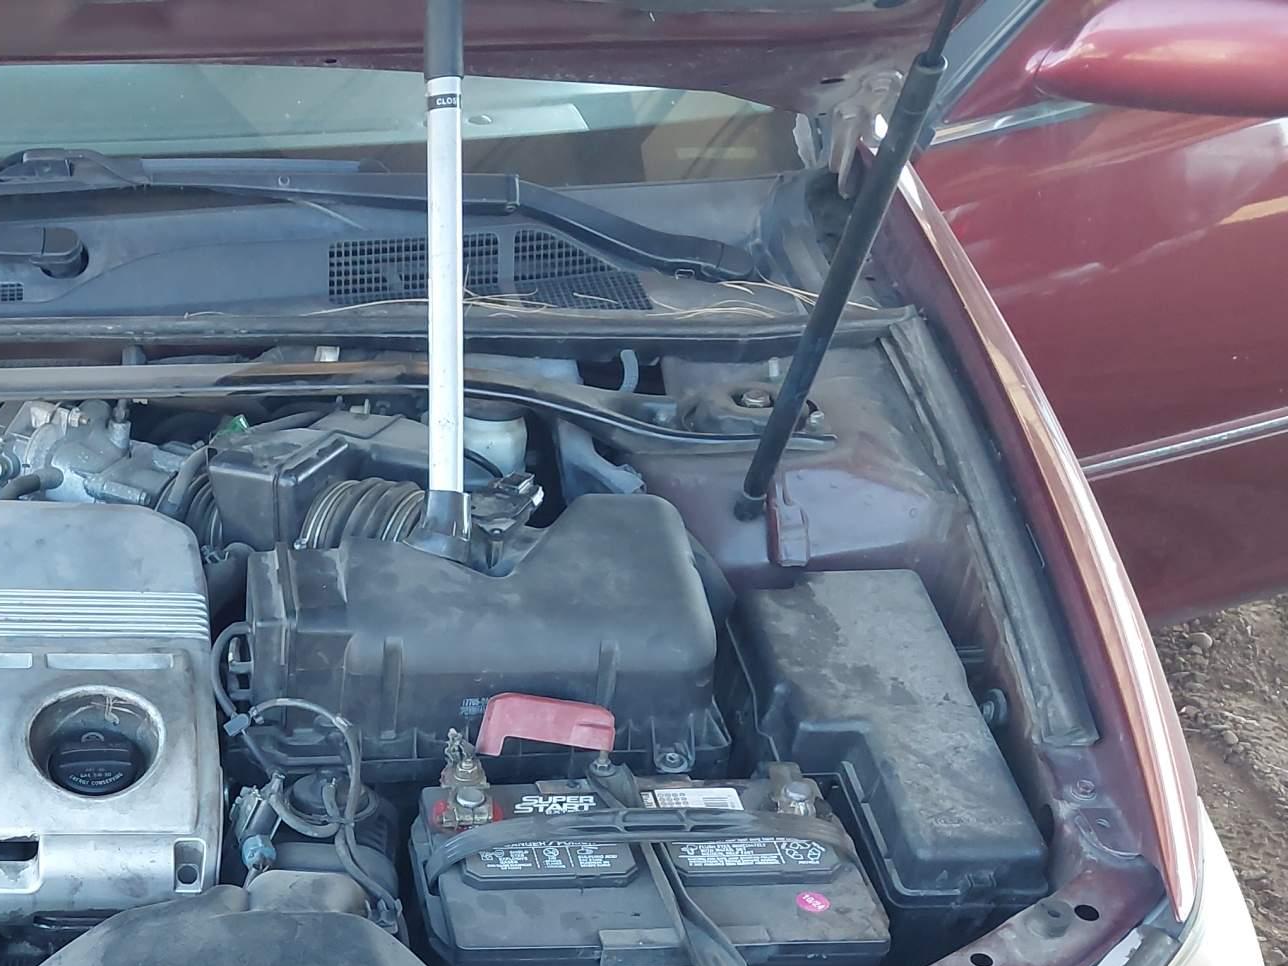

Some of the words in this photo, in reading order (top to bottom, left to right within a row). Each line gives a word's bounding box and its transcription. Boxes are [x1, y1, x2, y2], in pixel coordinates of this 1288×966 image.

[436, 97, 458, 105] CLOS
[522, 795, 594, 804] SUPER
[514, 802, 597, 813] START
